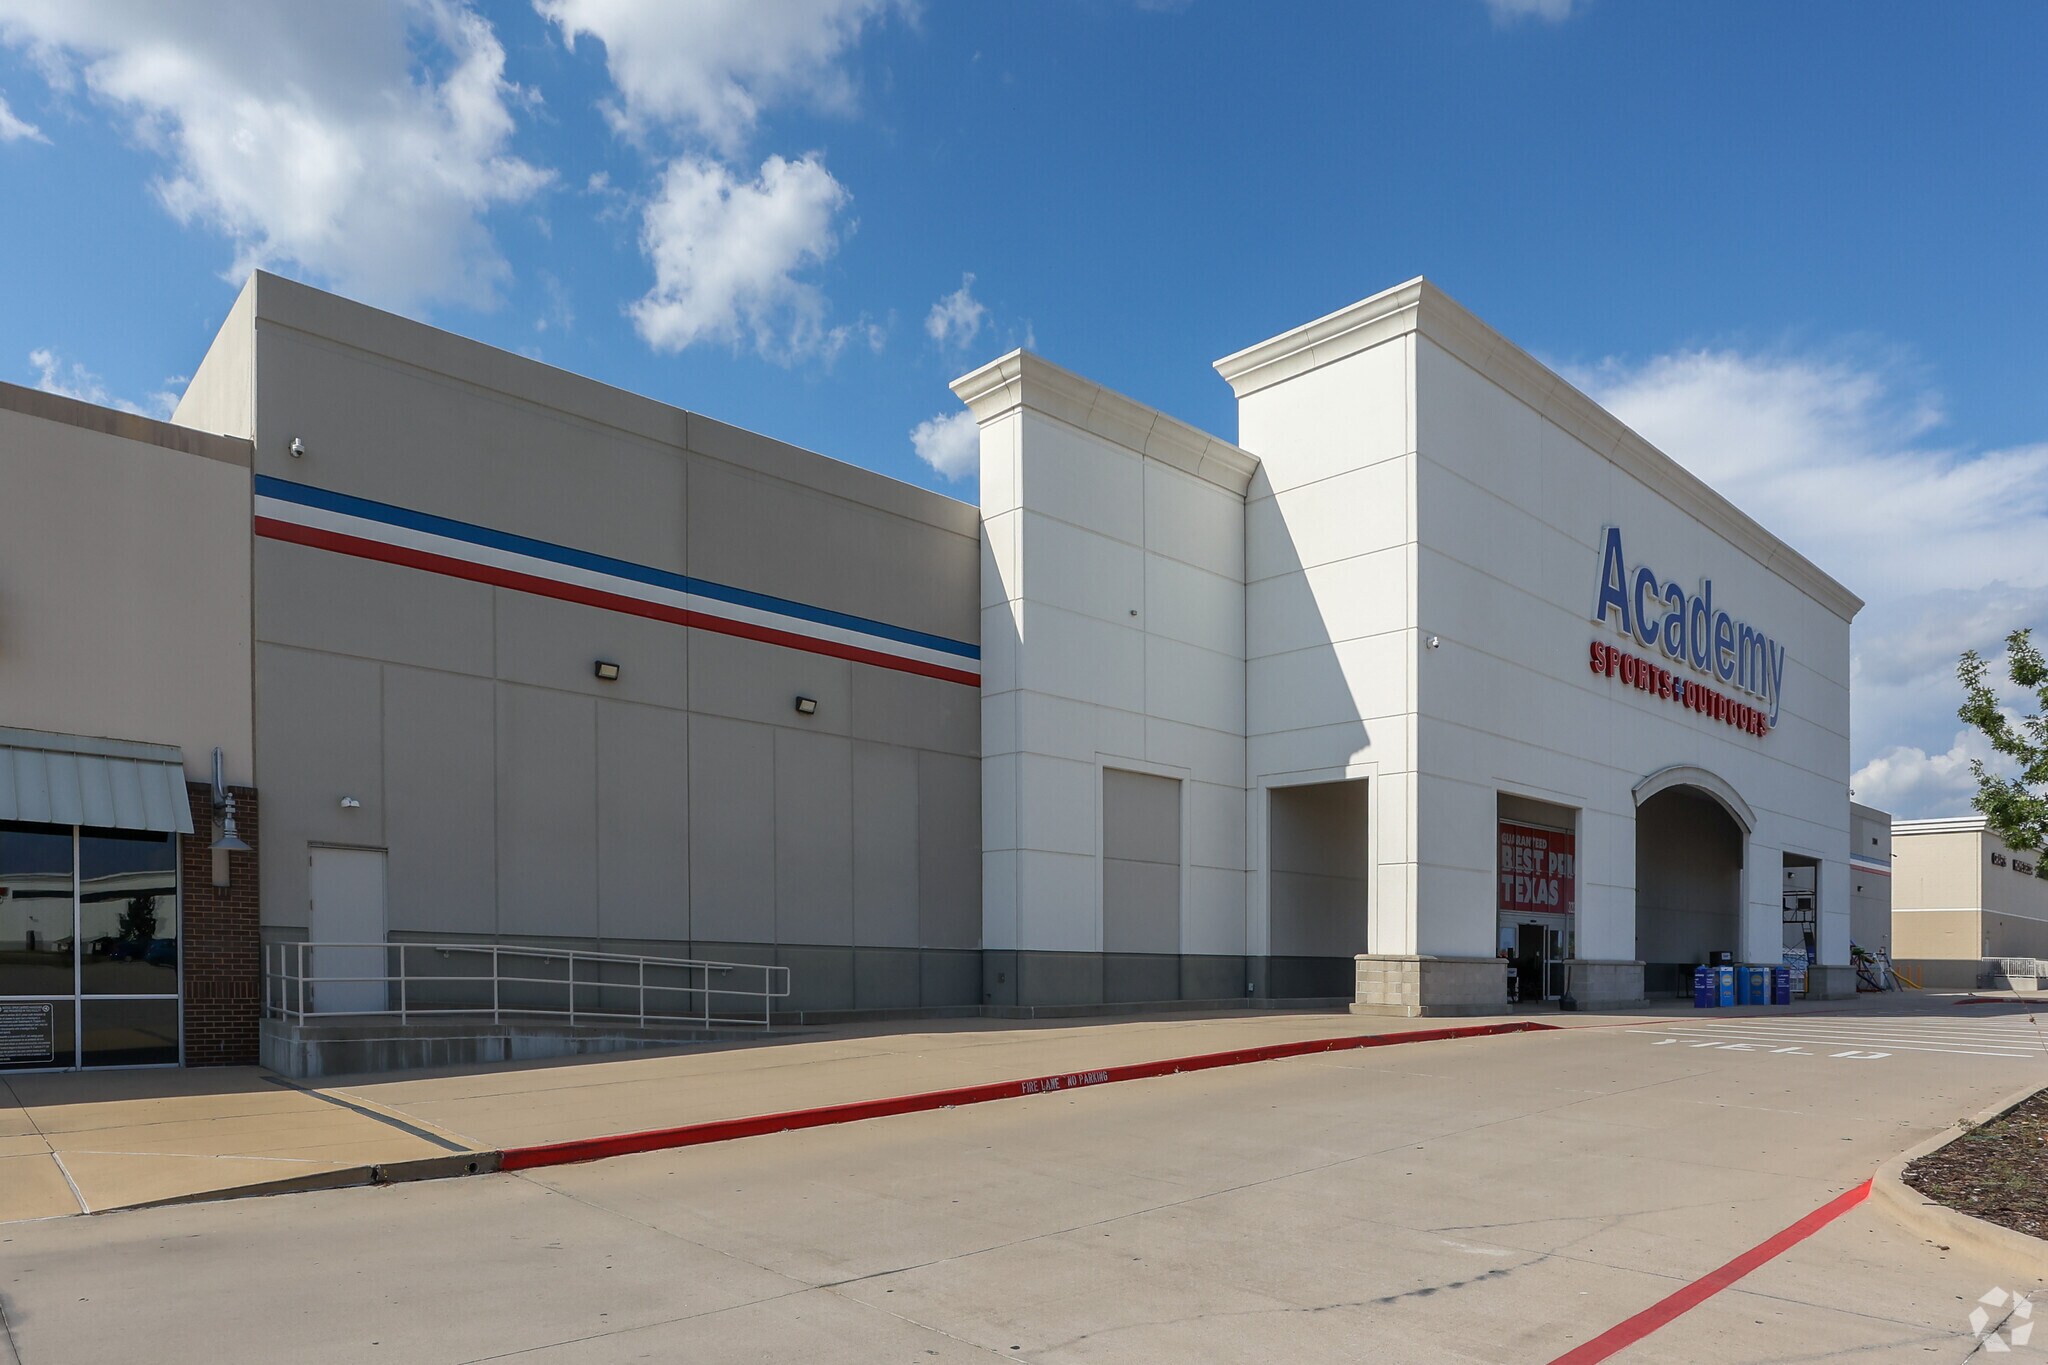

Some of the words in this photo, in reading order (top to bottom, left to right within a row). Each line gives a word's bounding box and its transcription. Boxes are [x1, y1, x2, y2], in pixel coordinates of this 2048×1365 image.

[1593, 527, 1785, 729] Academy
[1590, 641, 1673, 700] SPORTS
[1683, 679, 1768, 737] OUTDOORS
[1502, 847, 1544, 875] BEST
[1502, 875, 1558, 905] TEXAS
[1651, 1038, 1893, 1060] YIELD
[1022, 1081, 1039, 1094] FIRE
[1041, 1077, 1060, 1091] LANE
[1067, 1075, 1077, 1086] NO
[1079, 1071, 1108, 1085] PARKING
